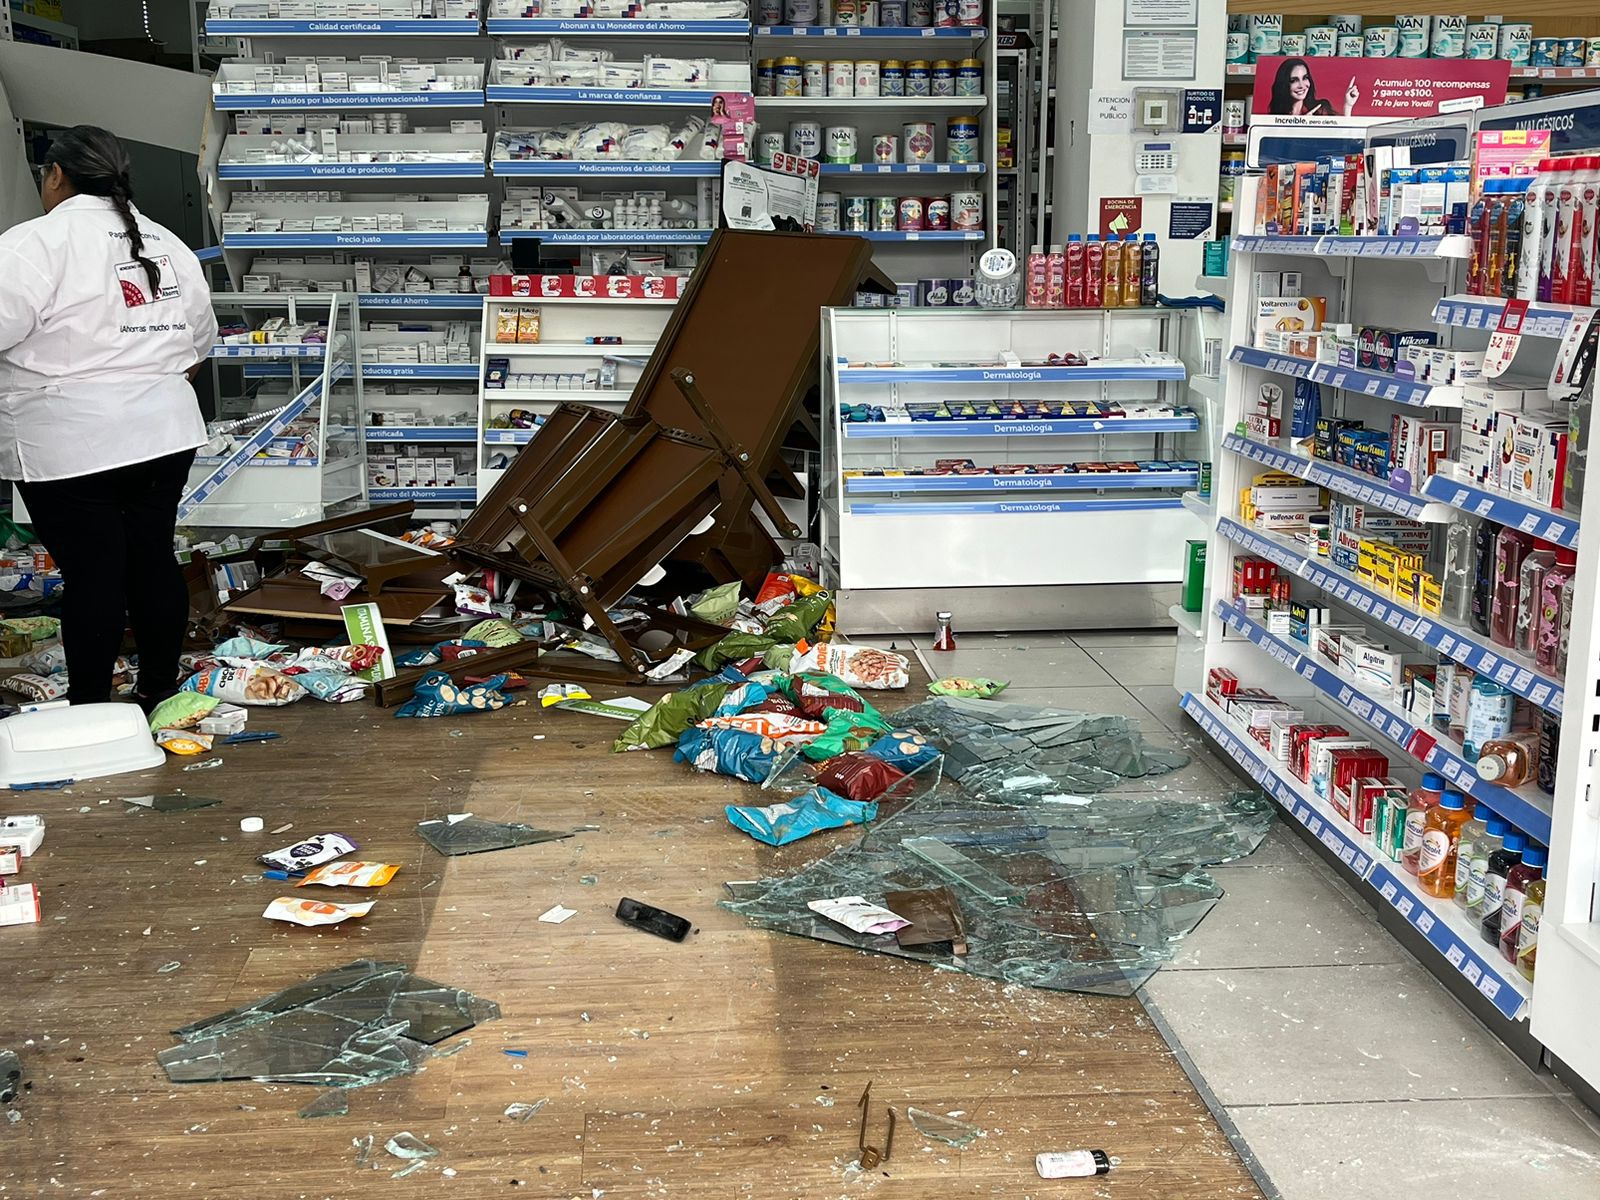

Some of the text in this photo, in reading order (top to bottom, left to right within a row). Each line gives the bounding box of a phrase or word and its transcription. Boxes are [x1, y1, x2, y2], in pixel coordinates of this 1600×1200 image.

[309, 22, 381, 30] Calidad certificada
[560, 22, 588, 30] Abonan
[607, 22, 648, 30] Monedero
[649, 22, 658, 30] del
[659, 22, 686, 30] Ahorro
[1396, 18, 1423, 28] NAN
[1337, 24, 1356, 33] AN
[1366, 34, 1386, 42] NAN
[1470, 32, 1494, 40] NAN
[1374, 79, 1490, 90] Acumulo 100 recompensas
[588, 92, 612, 100] marca
[613, 92, 622, 100] de
[623, 92, 662, 100] confianza
[1404, 88, 1434, 98] e$100.
[270, 96, 306, 104] Avalados
[322, 96, 368, 104] laboratorios
[370, 95, 428, 103] internacionales
[1393, 100, 1410, 108] juro
[1274, 116, 1308, 125] Increíble,
[794, 130, 815, 138] NAN
[831, 131, 851, 140] NAN
[311, 166, 396, 175] Variedad de productos
[579, 164, 671, 173] Medicamentos de calidad
[960, 198, 979, 206] NAN
[108, 231, 128, 240] Paga
[336, 236, 382, 244] Precio justo
[552, 232, 586, 240] Avalados
[600, 232, 644, 240] laboratorios
[645, 232, 702, 240] internacionales
[148, 324, 170, 332] mucho
[1400, 336, 1430, 346] Nikzon
[392, 368, 414, 376] gratis
[982, 370, 1042, 380] Dermatología
[994, 424, 1053, 434] Dermatología
[366, 430, 404, 438] certificada
[993, 477, 1052, 488] Dermatología
[399, 490, 410, 498] del
[411, 490, 436, 498] Ahorro
[1000, 502, 1060, 512] Dermatología
